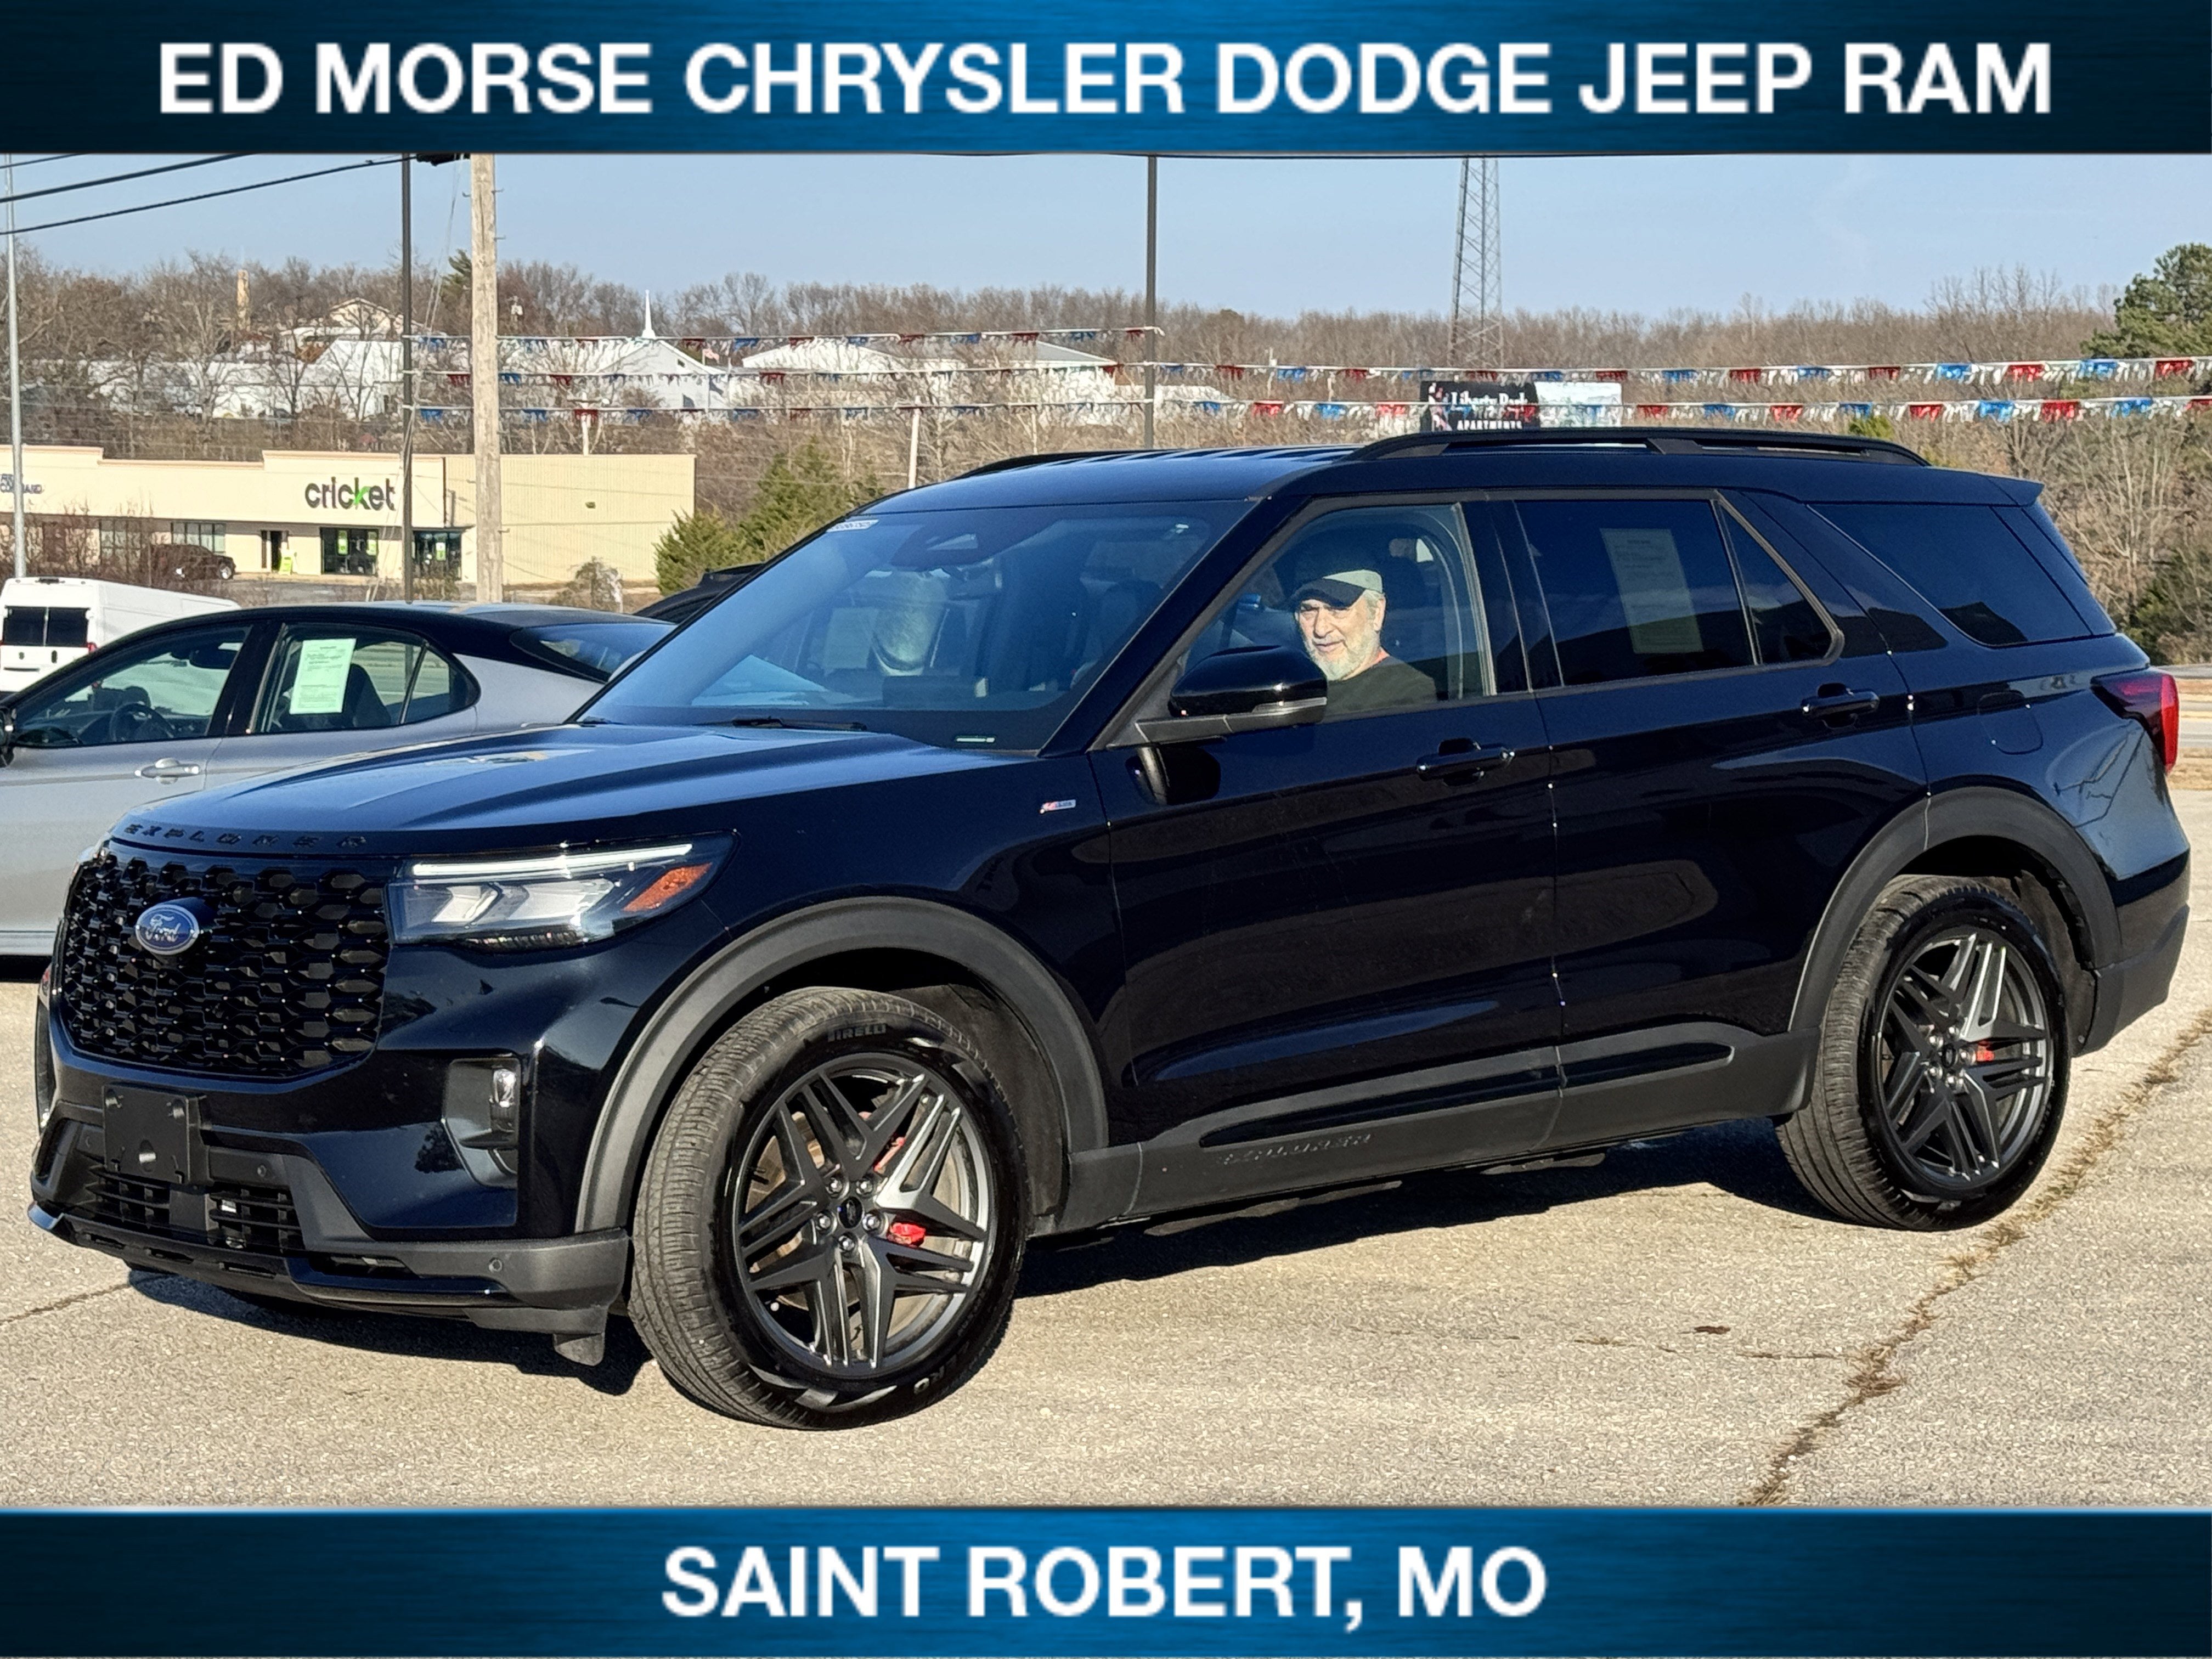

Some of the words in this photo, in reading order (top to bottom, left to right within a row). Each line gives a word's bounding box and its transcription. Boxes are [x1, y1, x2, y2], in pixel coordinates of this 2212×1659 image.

[304, 476, 397, 511] cricket
[123, 822, 369, 849] EXPLORER
[145, 913, 182, 943] Ford
